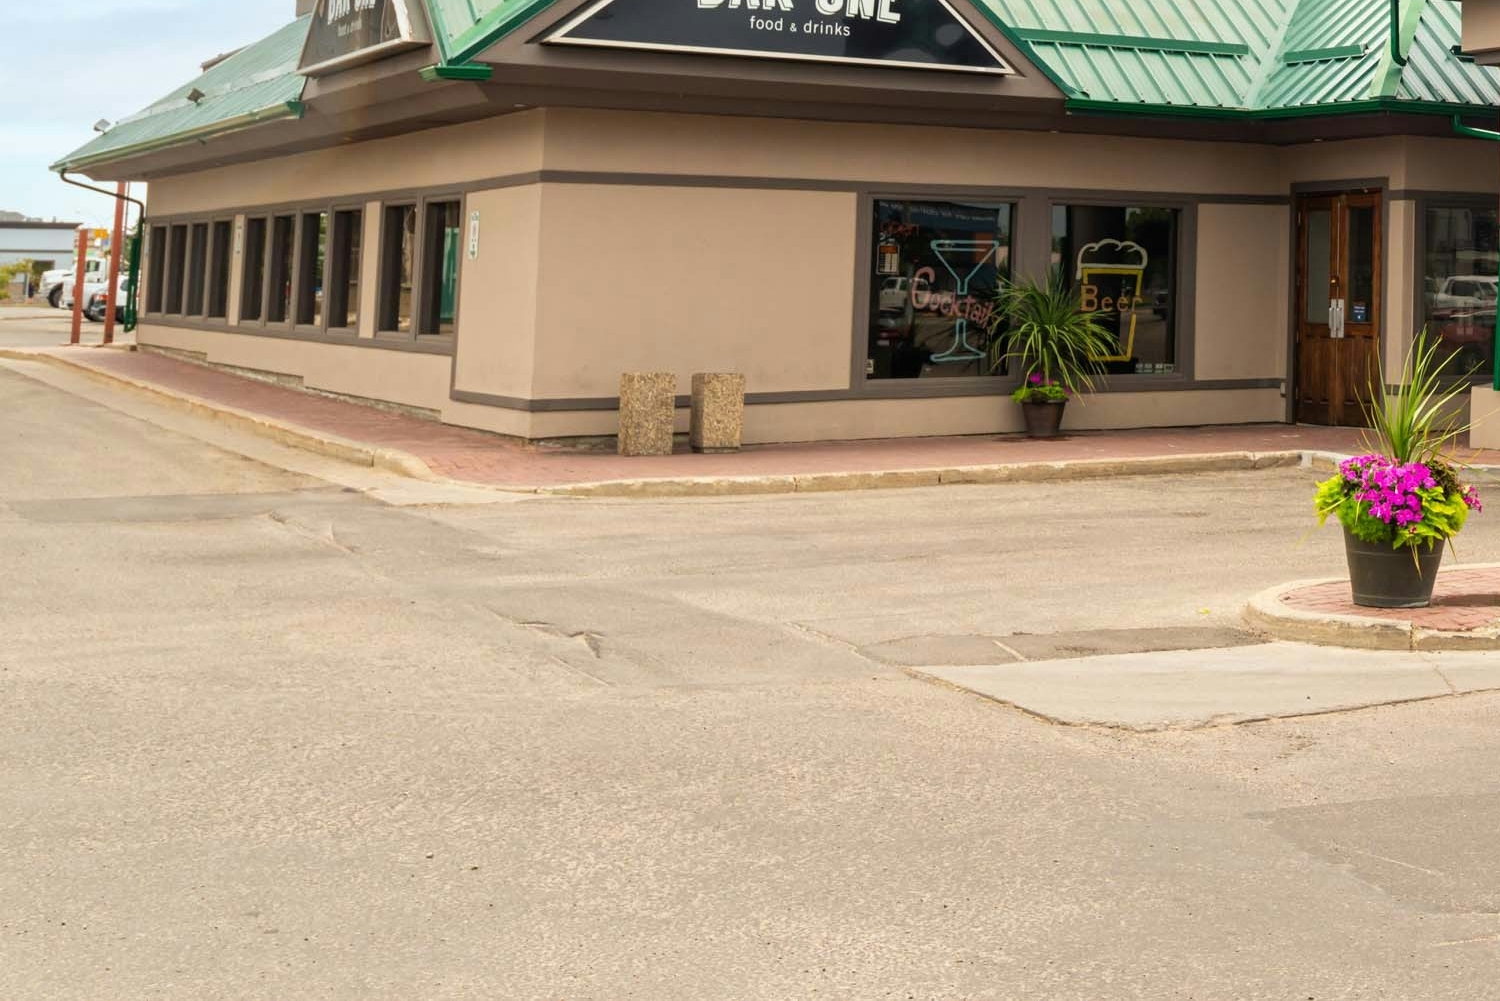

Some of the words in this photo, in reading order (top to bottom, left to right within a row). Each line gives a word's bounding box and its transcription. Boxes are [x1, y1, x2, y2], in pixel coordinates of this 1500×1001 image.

[750, 15, 784, 31] food
[789, 23, 797, 32] &
[803, 20, 851, 36] drinks
[1080, 284, 1144, 312] Beer
